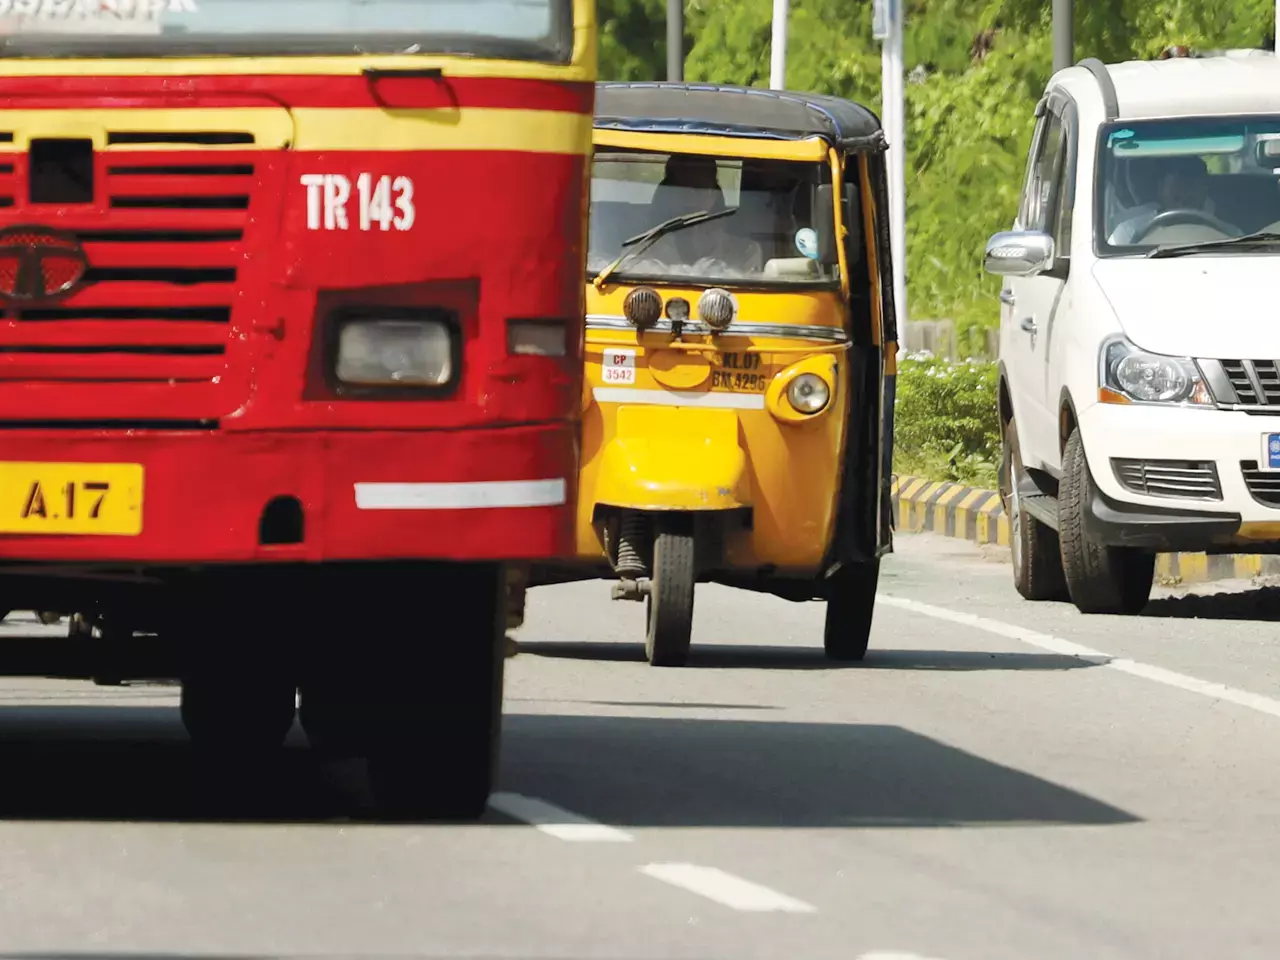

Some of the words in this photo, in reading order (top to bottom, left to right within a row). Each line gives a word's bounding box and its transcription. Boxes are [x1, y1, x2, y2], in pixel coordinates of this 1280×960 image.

[300, 174, 351, 230] TR
[357, 172, 415, 231] 143
[613, 354, 627, 365] CP
